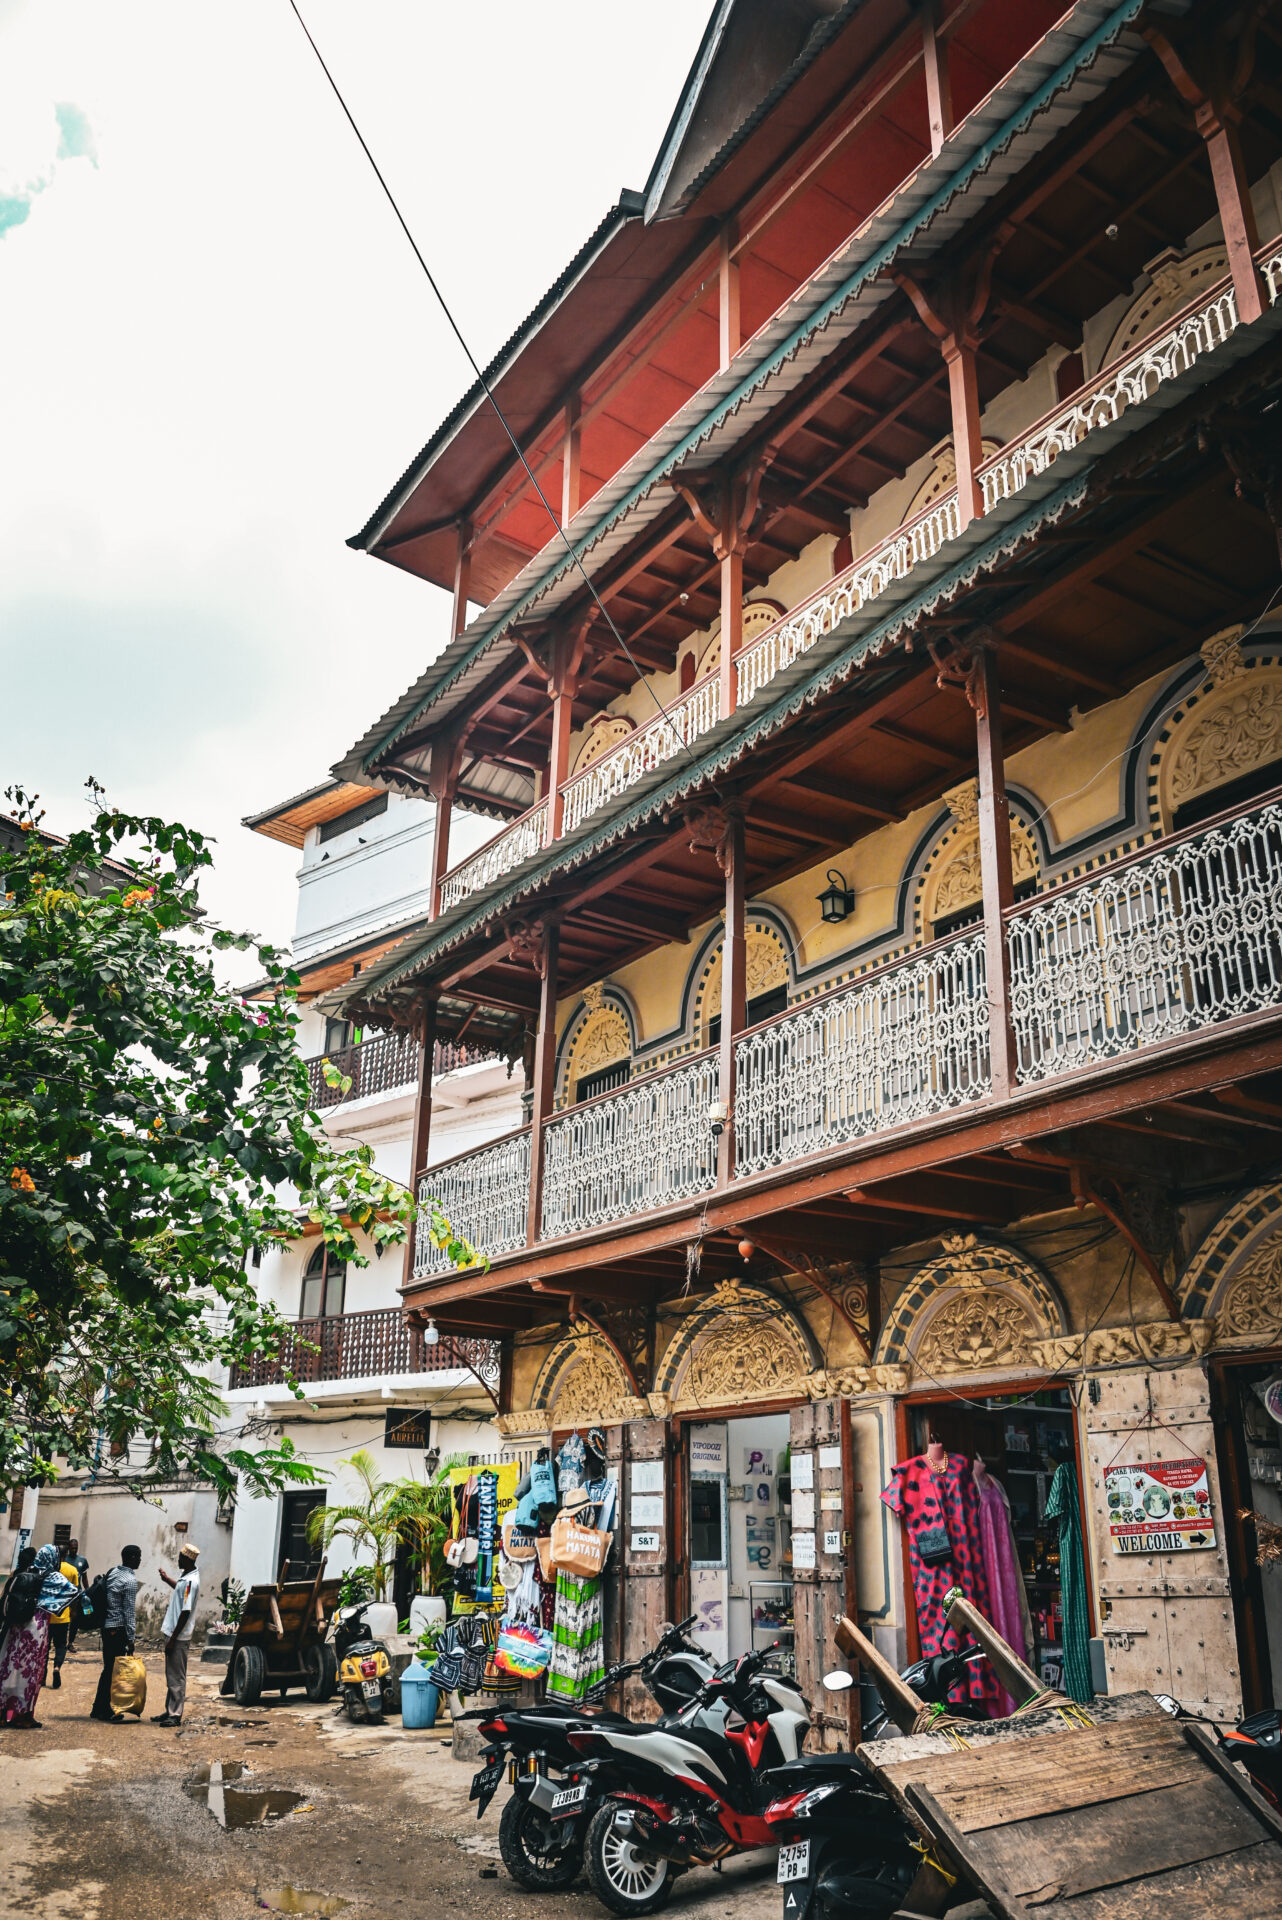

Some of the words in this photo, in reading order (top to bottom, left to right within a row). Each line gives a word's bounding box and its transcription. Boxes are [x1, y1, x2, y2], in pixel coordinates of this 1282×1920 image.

[391, 1432, 424, 1443] AURELIA
[692, 1441, 722, 1451] VIPODOZI
[692, 1452, 722, 1461] ORIGINAL
[1112, 1467, 1128, 1476] CAKE
[1128, 1464, 1146, 1475] TOOLS
[496, 1498, 513, 1509] HOP
[566, 1529, 602, 1547] HAKUNA
[638, 1537, 655, 1546] S&T
[827, 1535, 838, 1545] S&T
[1118, 1533, 1182, 1552] WELCOME
[566, 1541, 601, 1560] MATATA
[788, 1862, 798, 1878] PB
